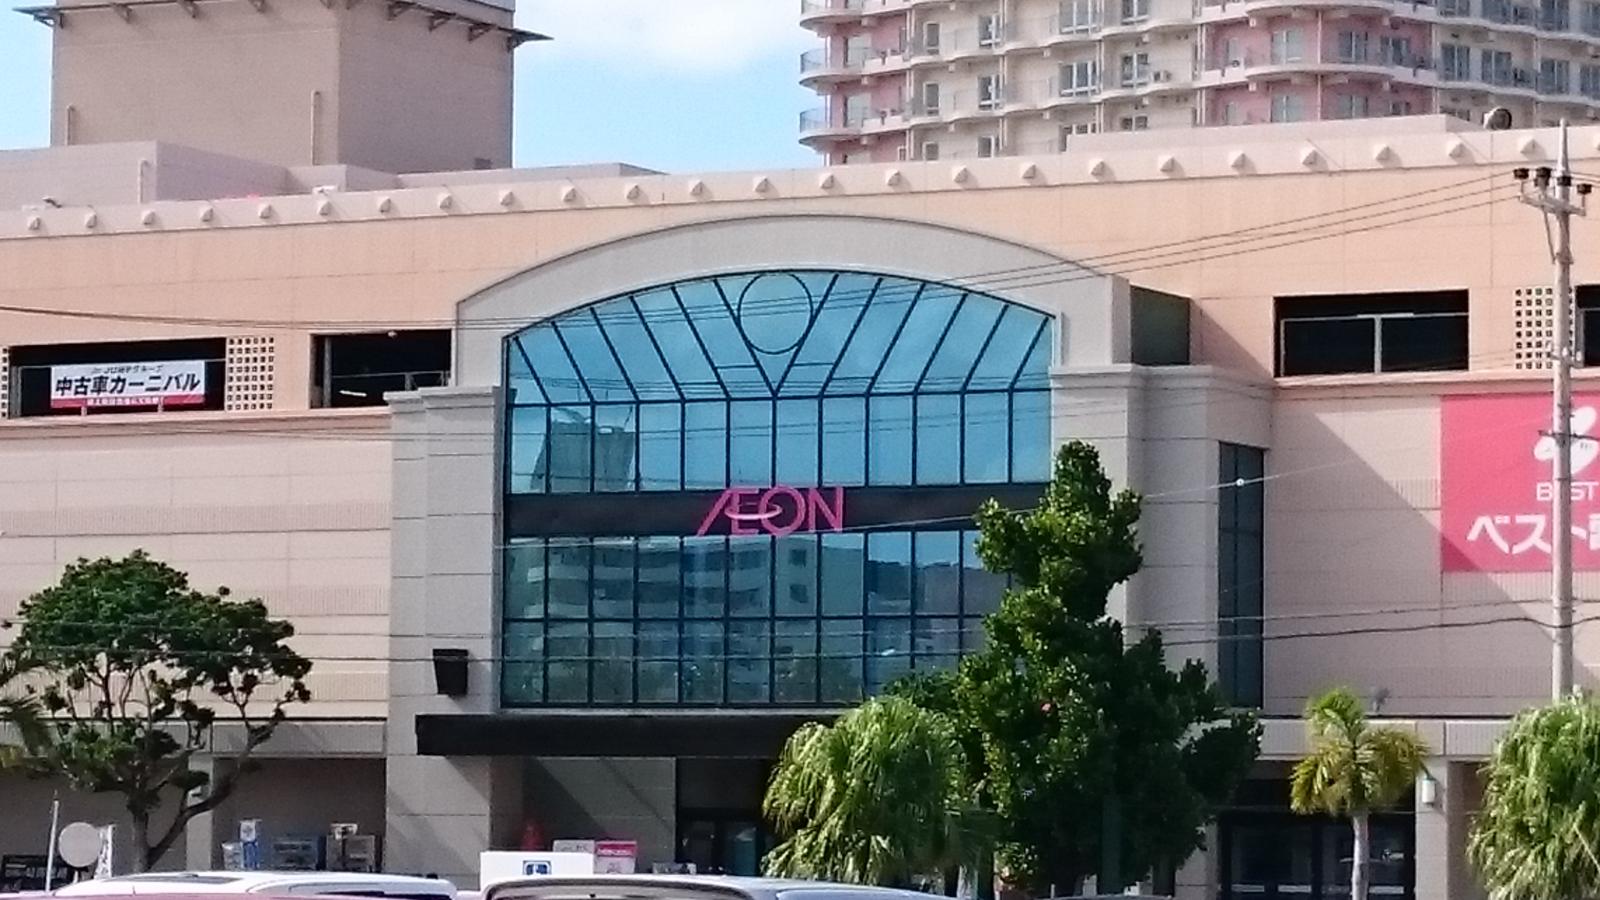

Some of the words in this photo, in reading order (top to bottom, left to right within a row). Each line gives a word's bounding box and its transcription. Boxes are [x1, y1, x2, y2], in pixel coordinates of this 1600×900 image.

[55, 373, 201, 396] 中古車カーニバル
[1536, 481, 1599, 501] BST
